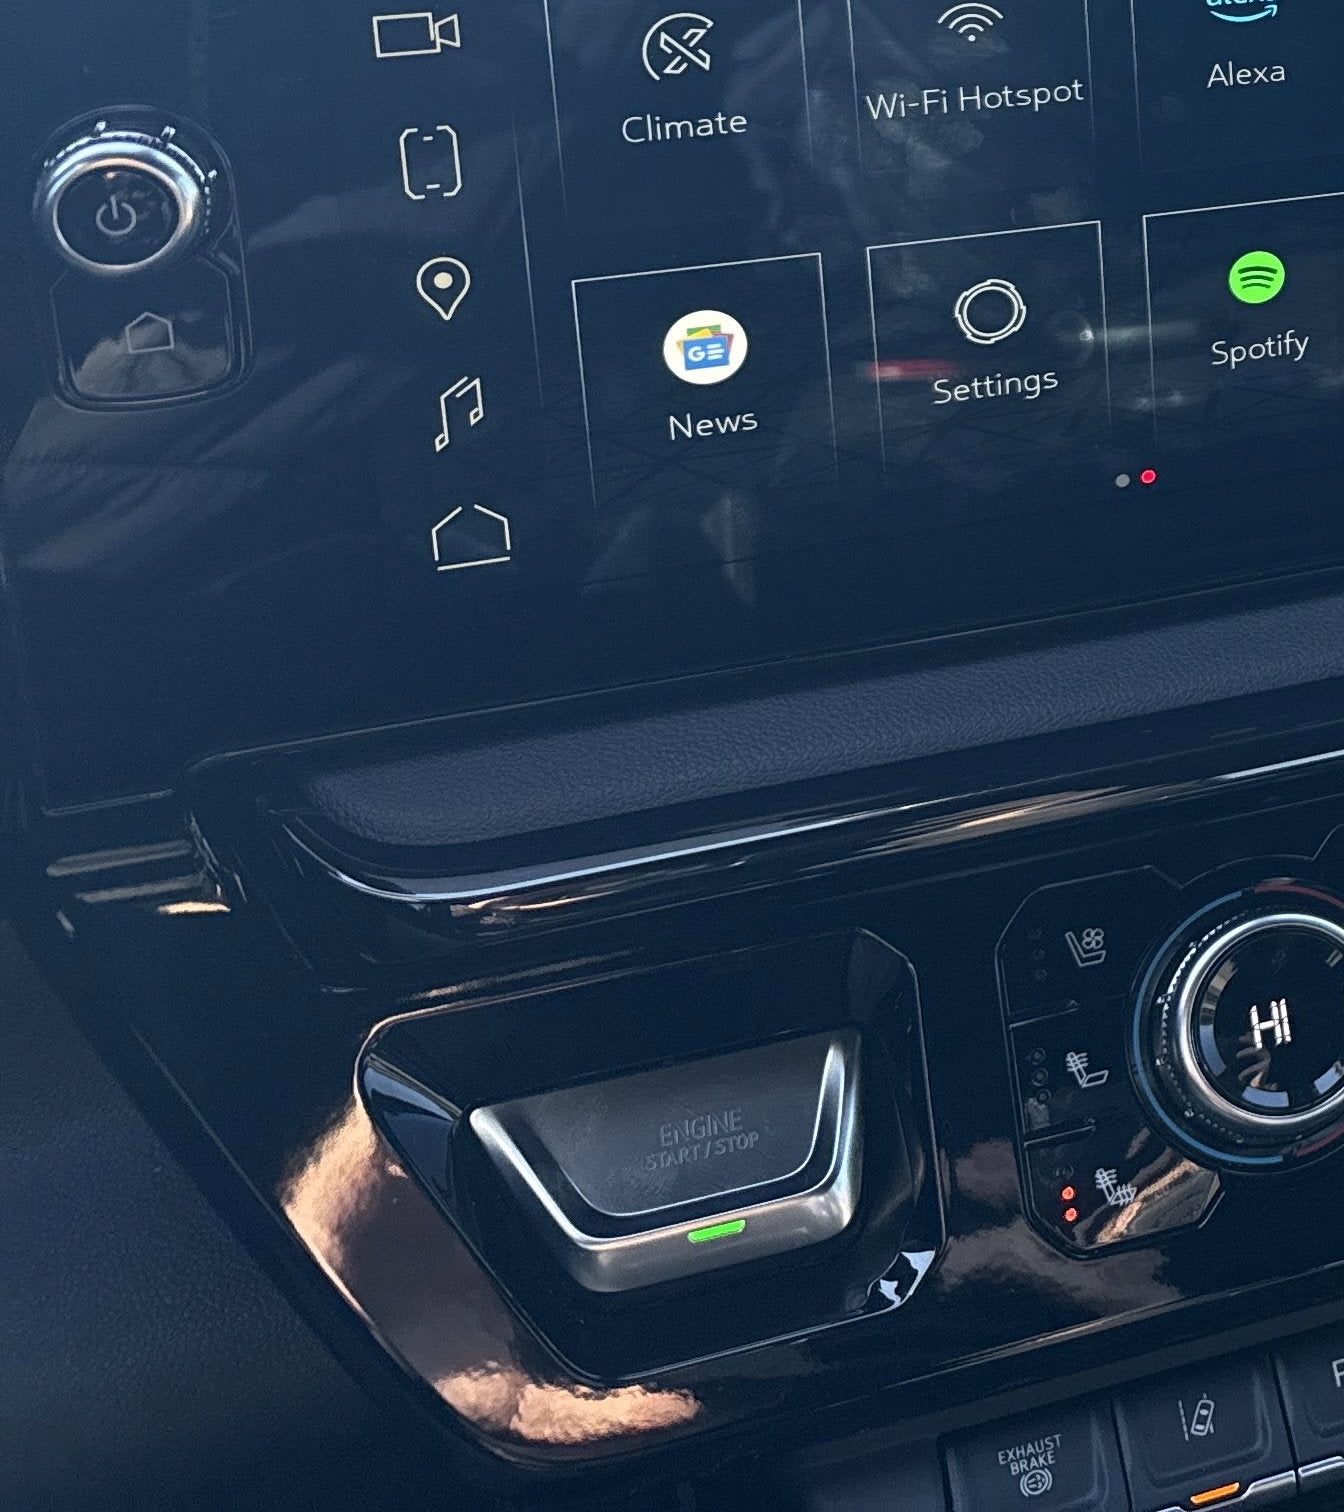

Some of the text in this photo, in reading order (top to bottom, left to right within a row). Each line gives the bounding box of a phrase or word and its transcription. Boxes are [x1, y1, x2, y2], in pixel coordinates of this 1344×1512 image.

[1207, 60, 1286, 88] Alexa
[865, 79, 1084, 120] Wi-Fi Hotspot
[622, 111, 748, 144] Climate
[1211, 330, 1310, 370] Spotify
[932, 368, 1059, 405] Settings
[669, 411, 758, 441] News
[1249, 998, 1292, 1050] HI
[660, 1108, 744, 1148] ENGINE
[997, 1433, 1062, 1466] EXHAUST
[1009, 1454, 1056, 1476] BRAKE
